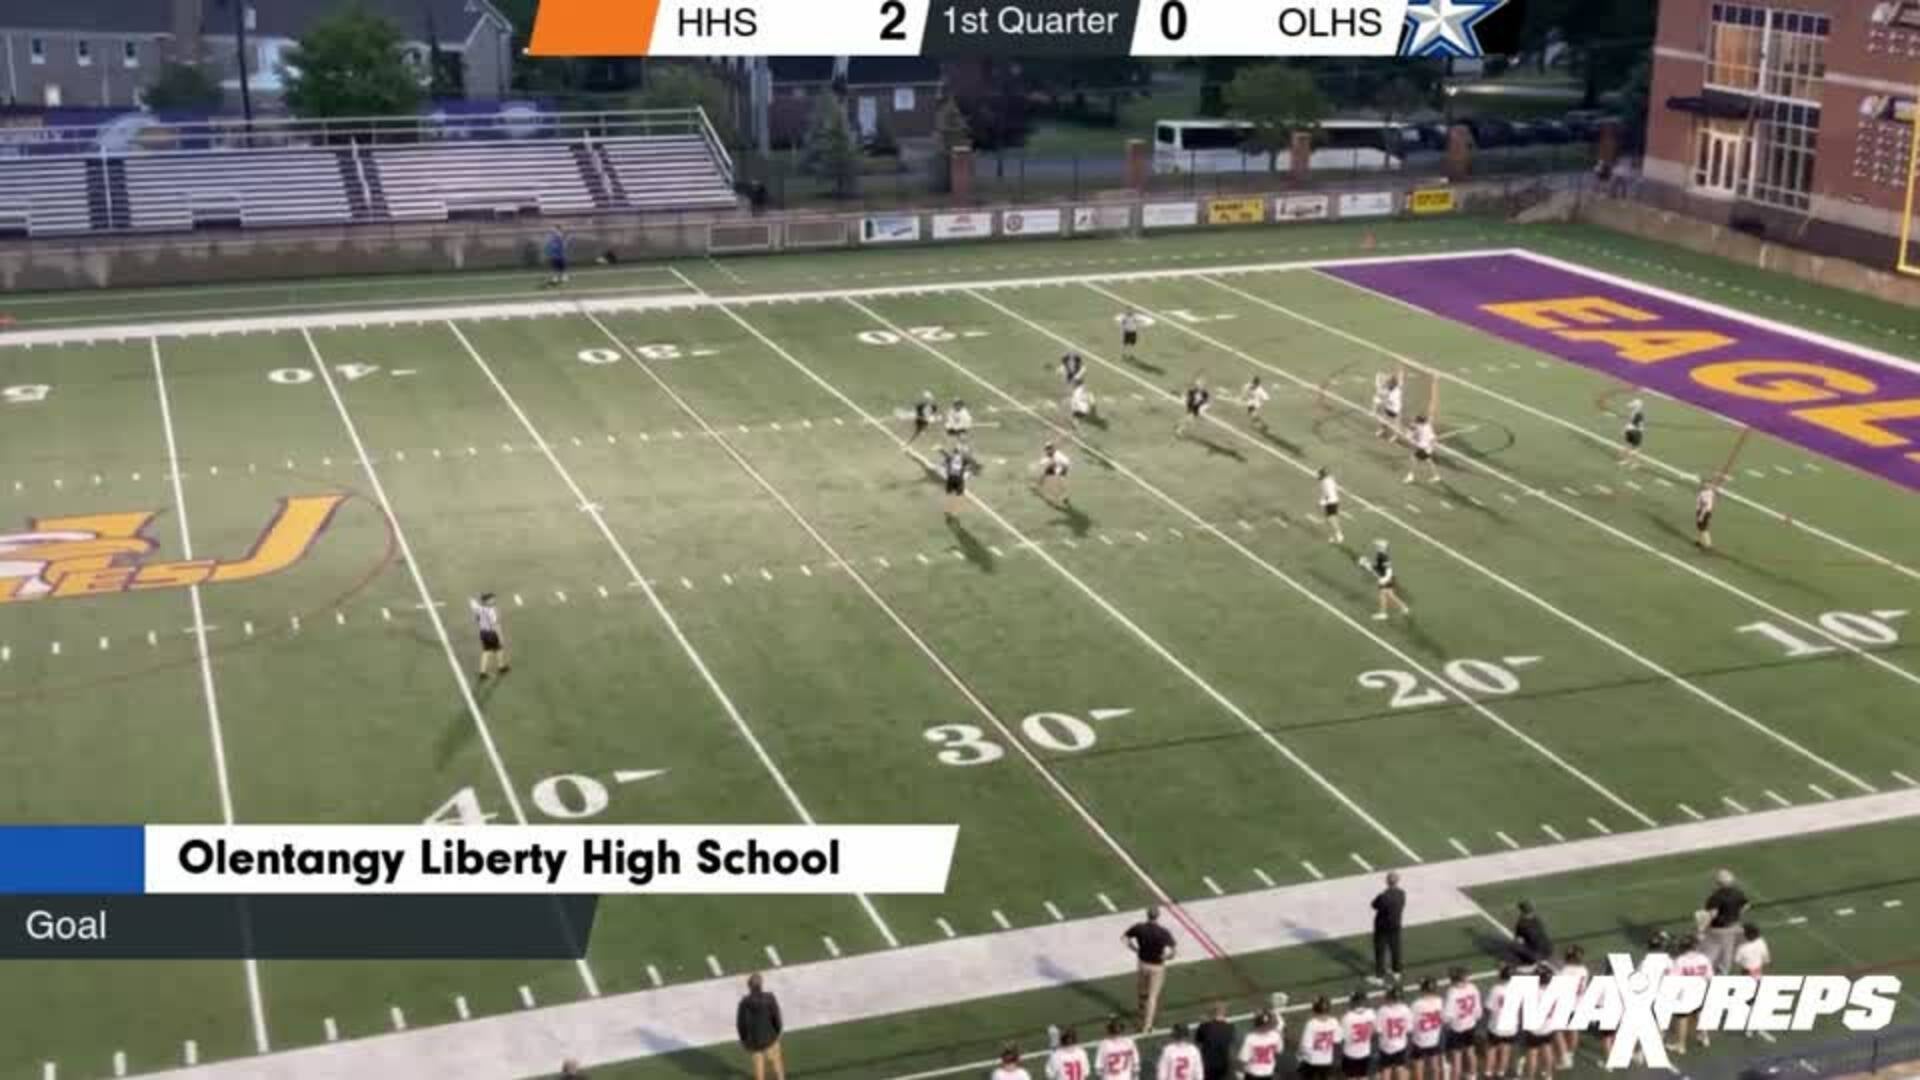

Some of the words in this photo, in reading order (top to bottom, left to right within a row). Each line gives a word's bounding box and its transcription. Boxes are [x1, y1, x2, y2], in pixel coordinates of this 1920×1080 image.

[1477, 297, 1920, 465] EAGL
[1735, 610, 1899, 657] 10
[1357, 658, 1521, 708] 20
[922, 711, 1097, 766] 30
